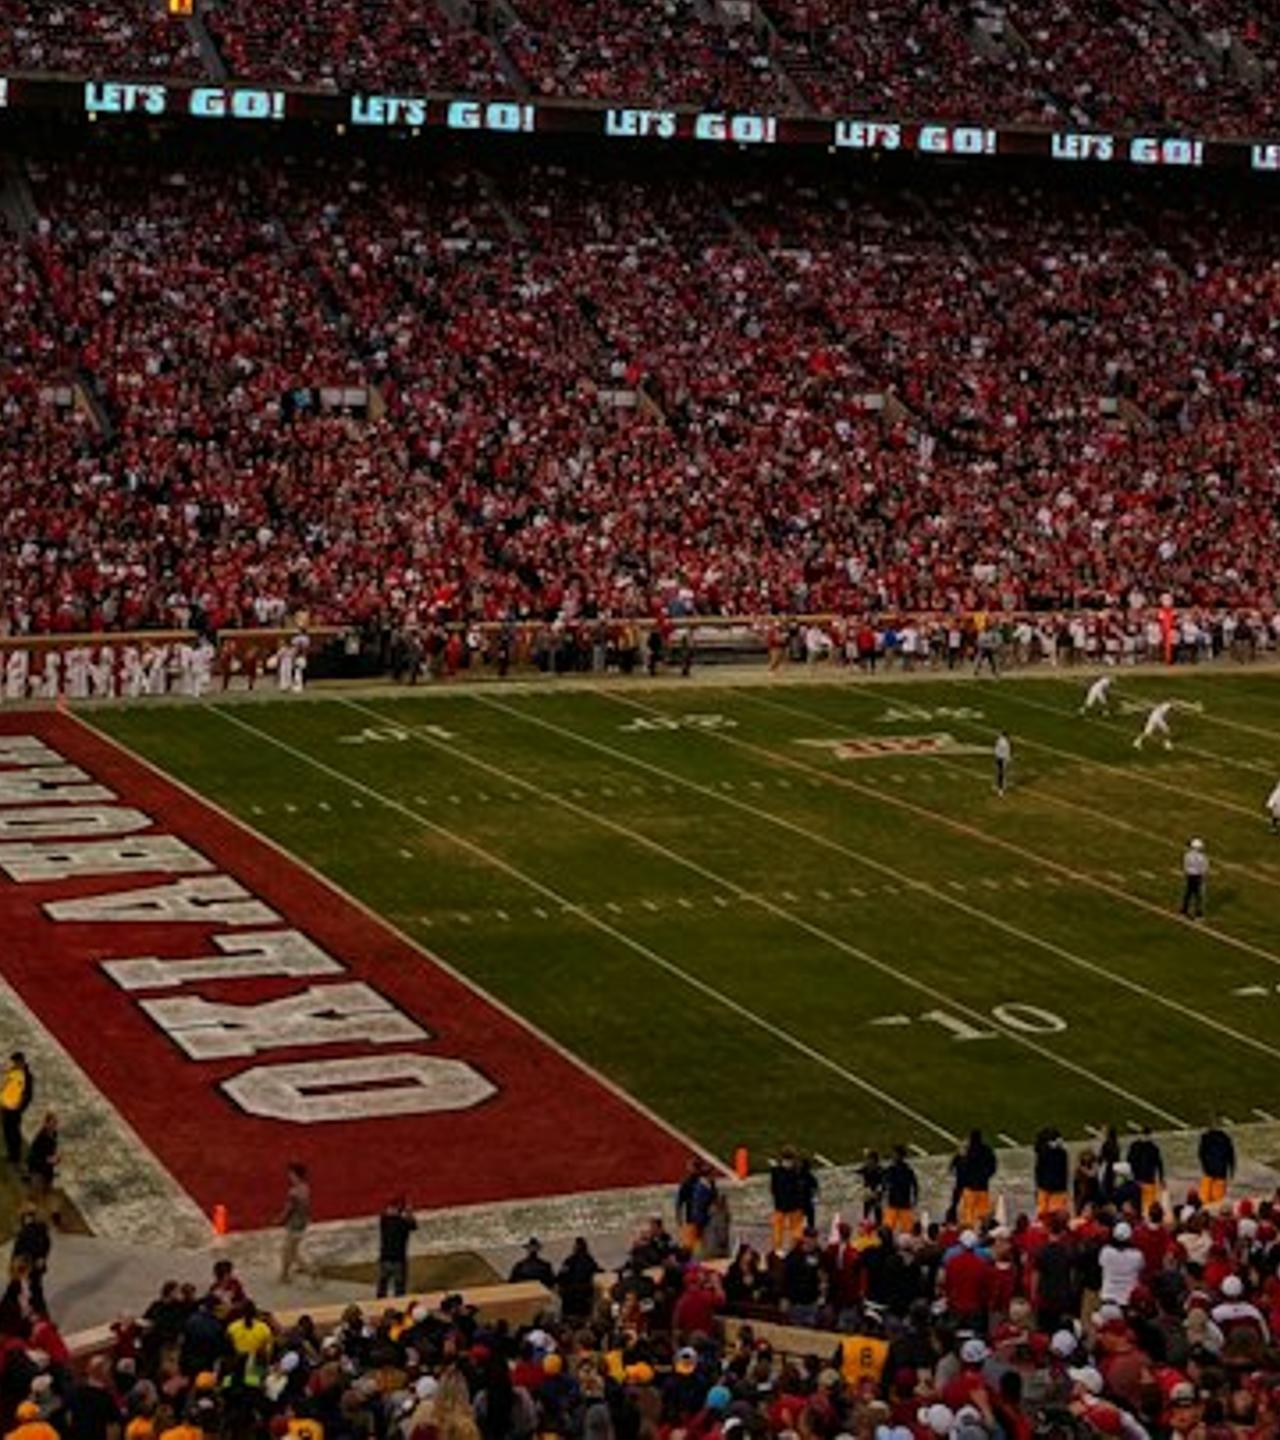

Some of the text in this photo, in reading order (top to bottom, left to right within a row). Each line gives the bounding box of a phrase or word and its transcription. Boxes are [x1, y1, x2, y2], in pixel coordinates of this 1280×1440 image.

[85, 82, 285, 119] LET'S GO!
[351, 95, 534, 132] LET'S GO!
[606, 109, 776, 143] LET'S GO!
[835, 121, 996, 154] LET'S GO!
[1052, 133, 1203, 165] LET'S GO!
[920, 1002, 1068, 1041] 10
